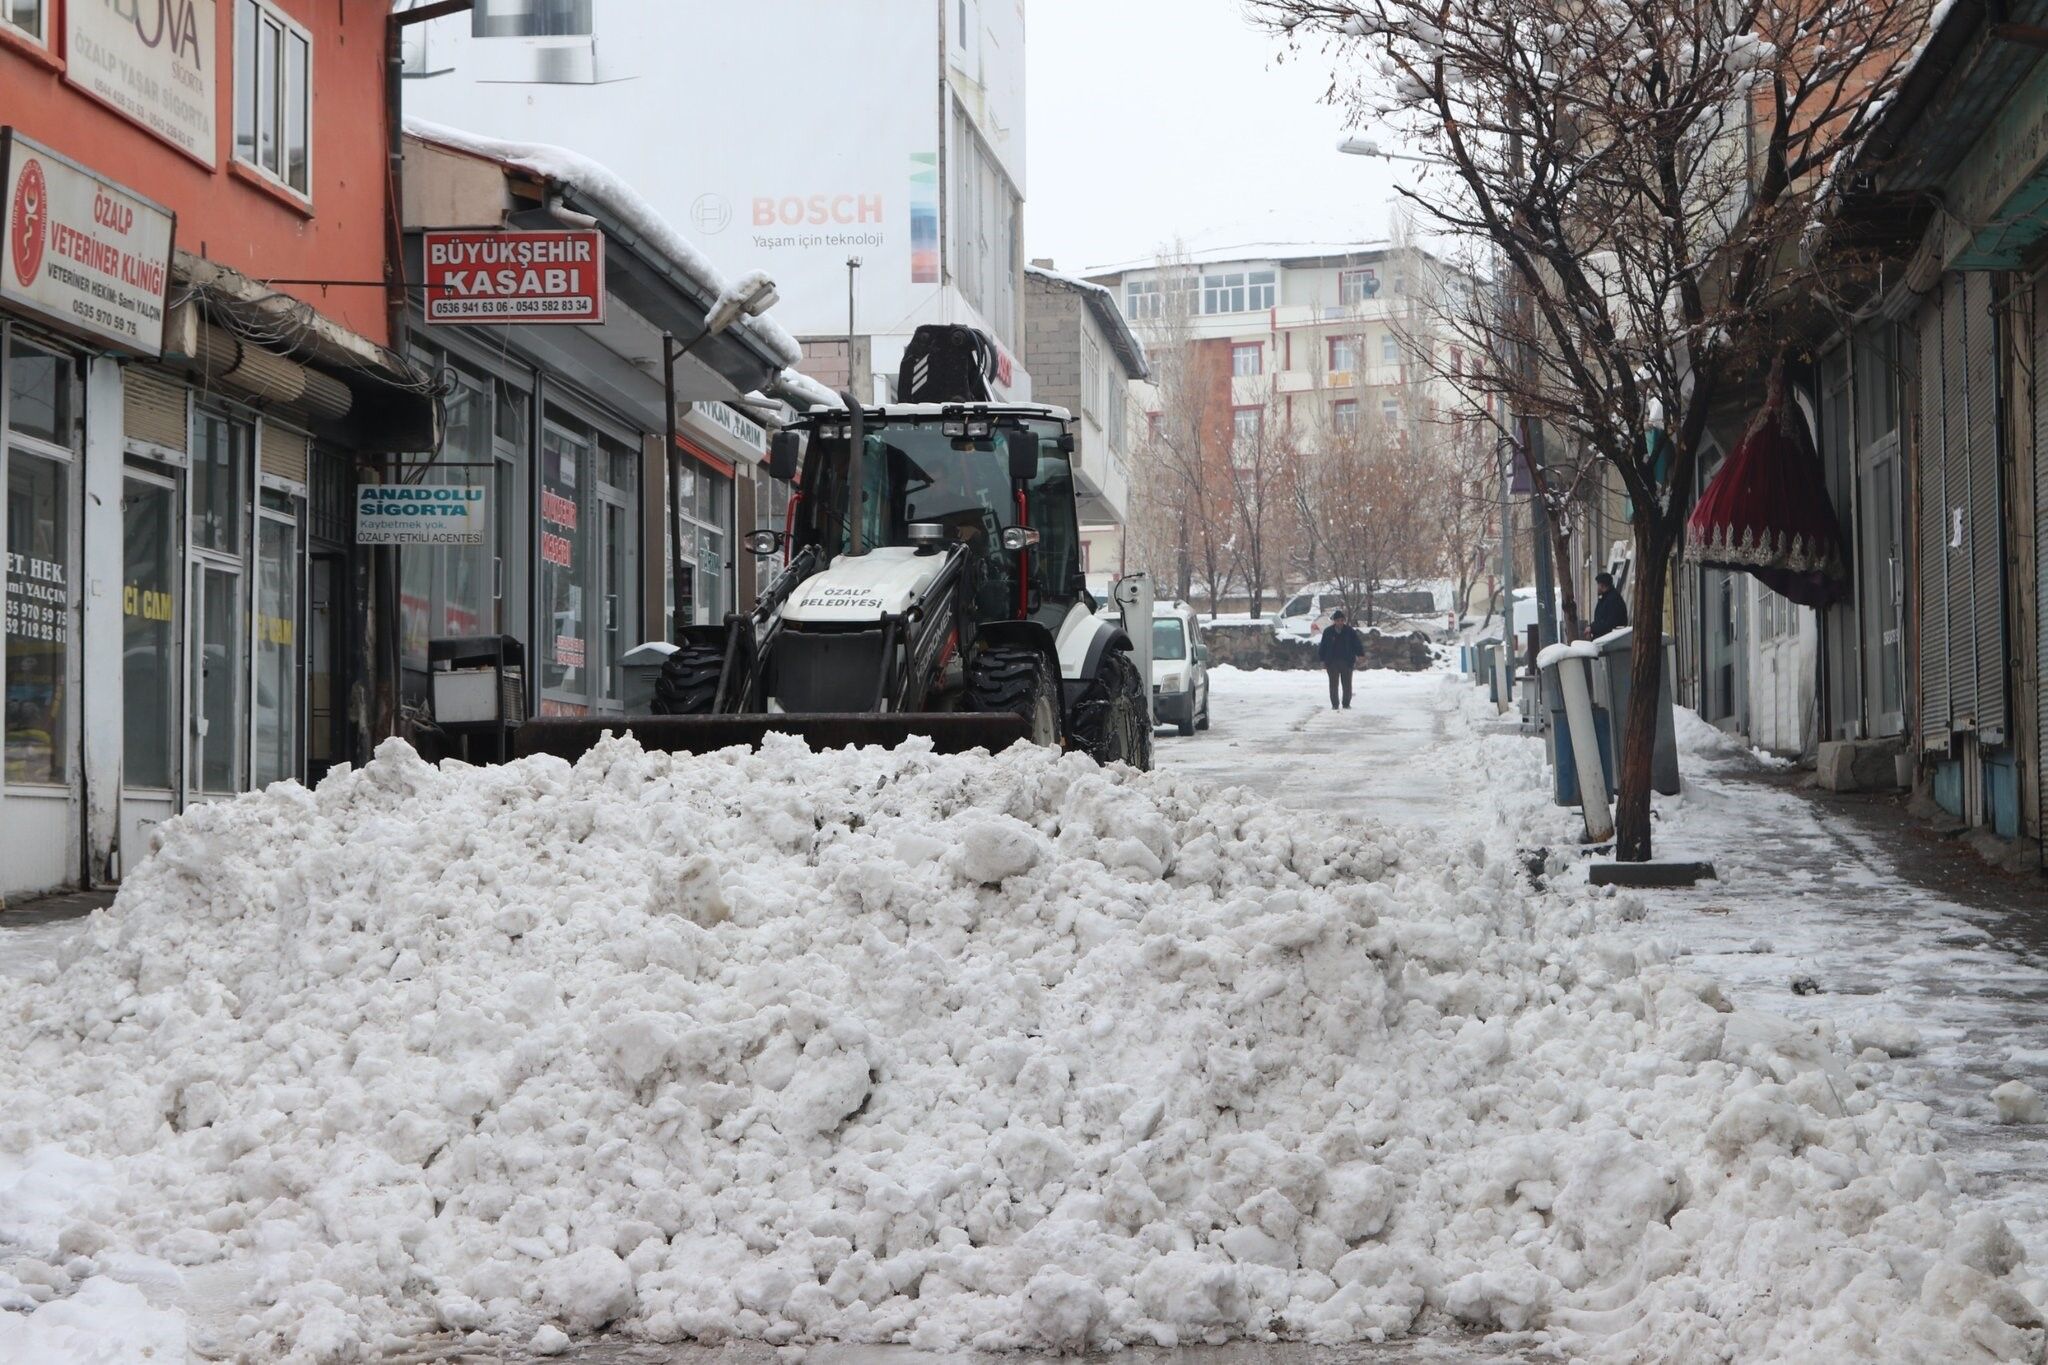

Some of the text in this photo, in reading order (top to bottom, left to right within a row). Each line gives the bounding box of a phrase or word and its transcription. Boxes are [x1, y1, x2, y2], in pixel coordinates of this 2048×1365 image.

[74, 27, 210, 136] ÖZALP YAŞAR SİGORTA
[94, 185, 134, 236] ÖZALP
[752, 193, 883, 226] BOSCH
[431, 236, 591, 268] BÜYÜKŞEHİR
[752, 232, 884, 249] Yaşam için teknoloji
[51, 220, 166, 297] VETERİNER KLİNİĞİ
[48, 262, 91, 293] VETERİNER
[118, 293, 136, 312] Sami
[136, 302, 161, 323] YALÇIN
[444, 269, 579, 296] KASABI
[72, 299, 137, 336] 0535 970 59 75
[437, 303, 459, 314] 0536
[462, 302, 479, 313] 941
[482, 302, 494, 312] 63
[496, 302, 508, 312] 06
[516, 301, 539, 312] 0543
[542, 301, 559, 311] 582
[562, 301, 574, 310] 83
[576, 300, 588, 311] 34
[699, 400, 731, 430] AYKAN
[733, 415, 761, 449] TARIM
[361, 488, 483, 501] ANADOLU
[360, 500, 468, 516] SİGORTA
[357, 530, 484, 543] ÖZALP YETKİLİ ACENTESİ
[360, 520, 448, 531] Kaybetmek yok.
[30, 558, 66, 584] HEK.
[25, 582, 66, 605] YALÇIN
[801, 597, 883, 609] BELEDİYESİ
[824, 587, 871, 597] ÖZALP
[21, 602, 40, 620] 970
[42, 607, 55, 623] 59
[56, 610, 67, 626] 75
[143, 590, 173, 621] CAM
[21, 620, 40, 638] 712
[41, 624, 54, 640] 23
[55, 627, 67, 643] 81
